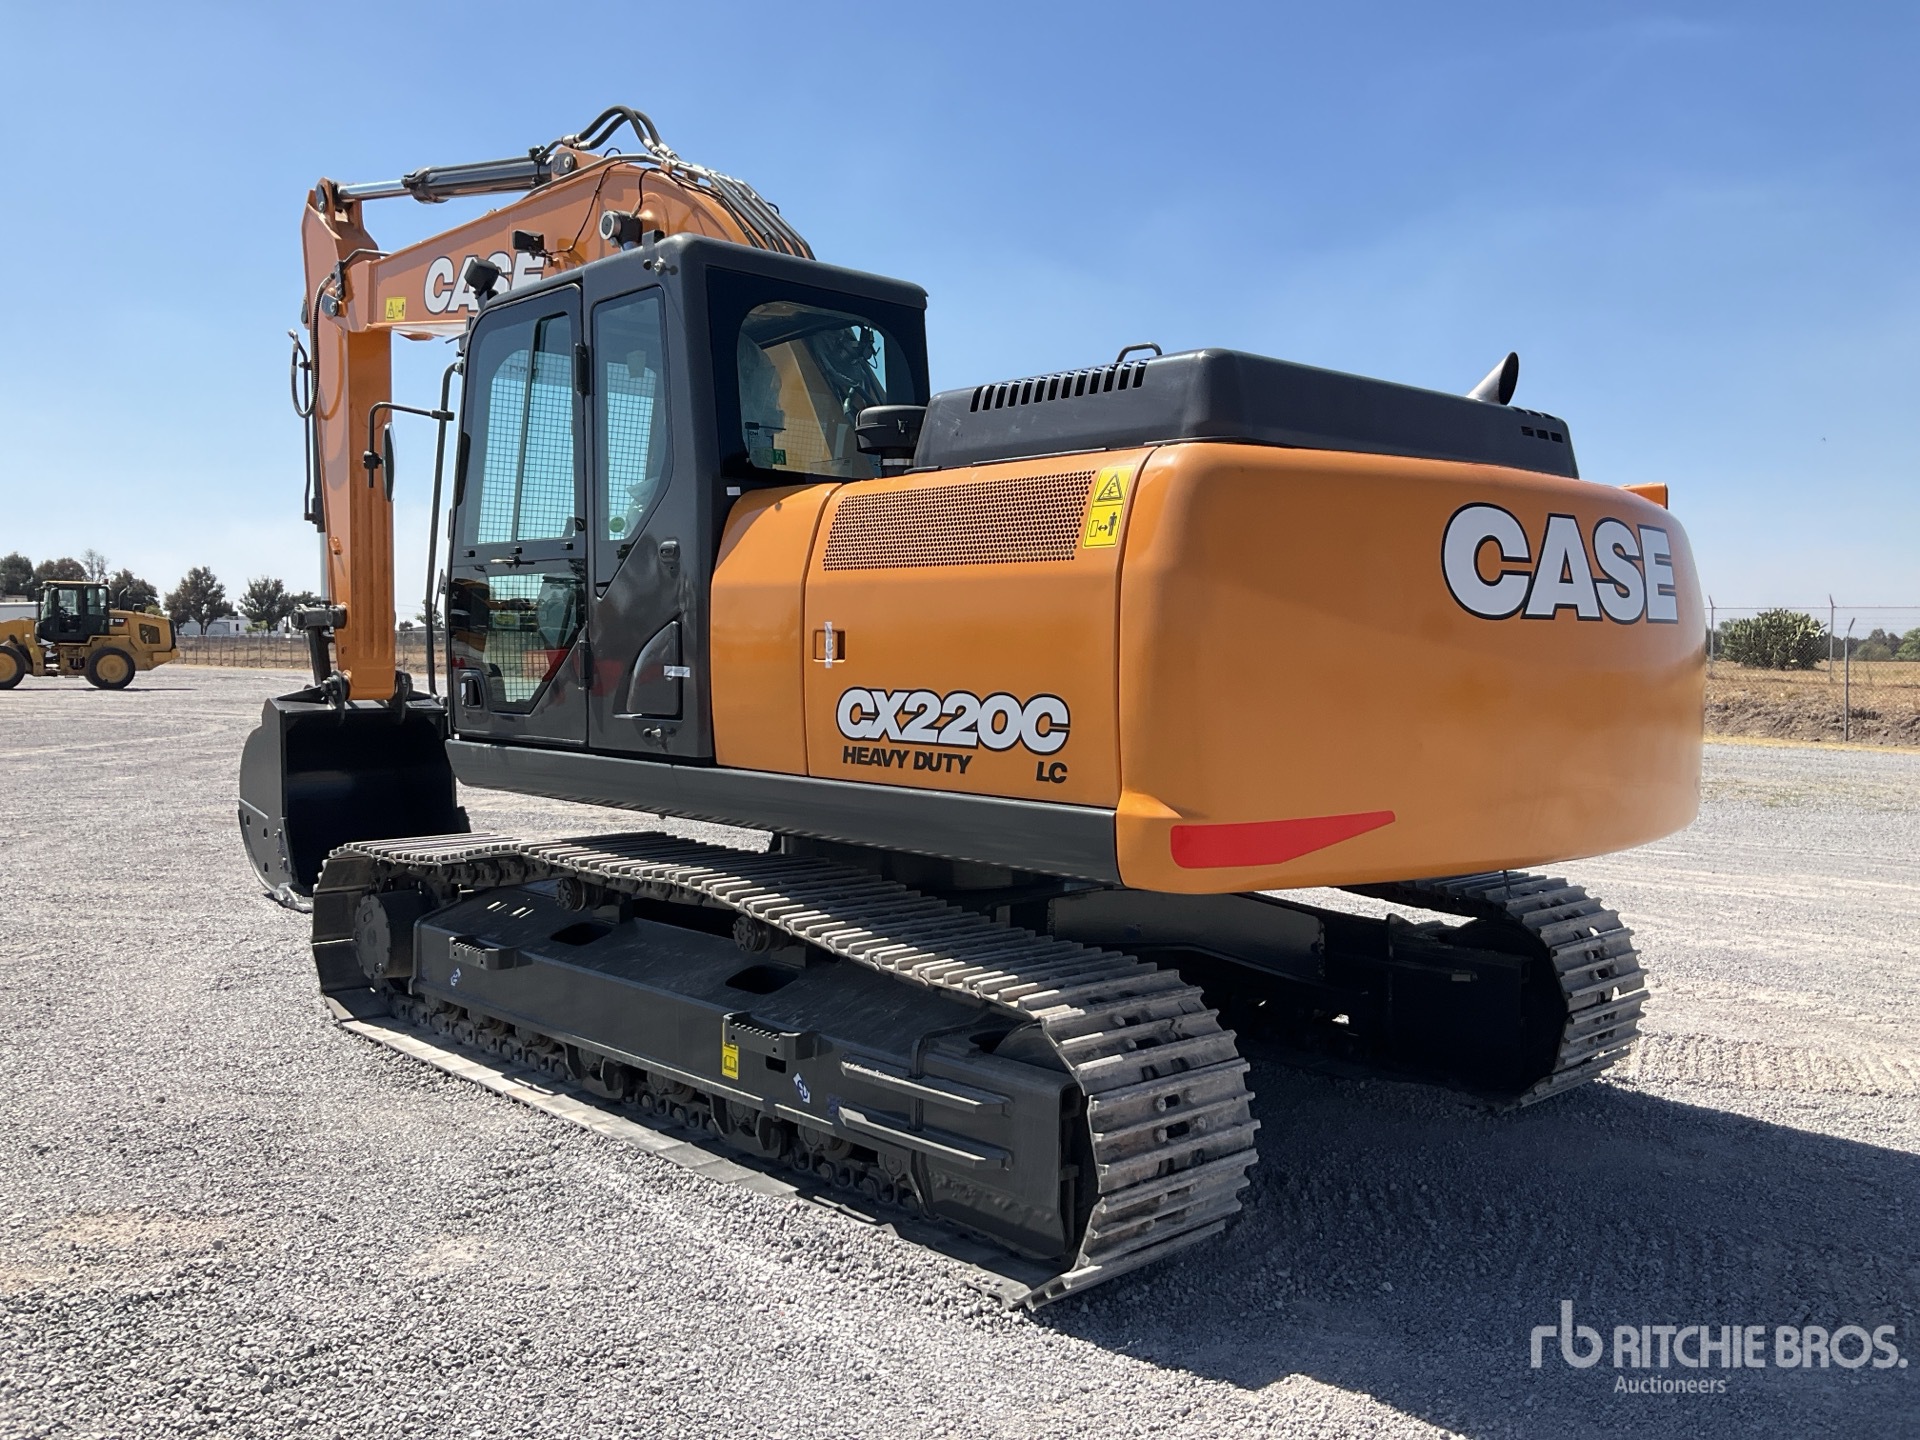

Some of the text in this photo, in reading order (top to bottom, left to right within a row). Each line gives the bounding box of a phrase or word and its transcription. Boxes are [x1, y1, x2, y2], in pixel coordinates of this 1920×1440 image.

[1441, 502, 1678, 625] CASE
[836, 687, 1070, 755] CX220C
[842, 745, 972, 774] HEAVY DUTY
[1036, 761, 1068, 783] LC
